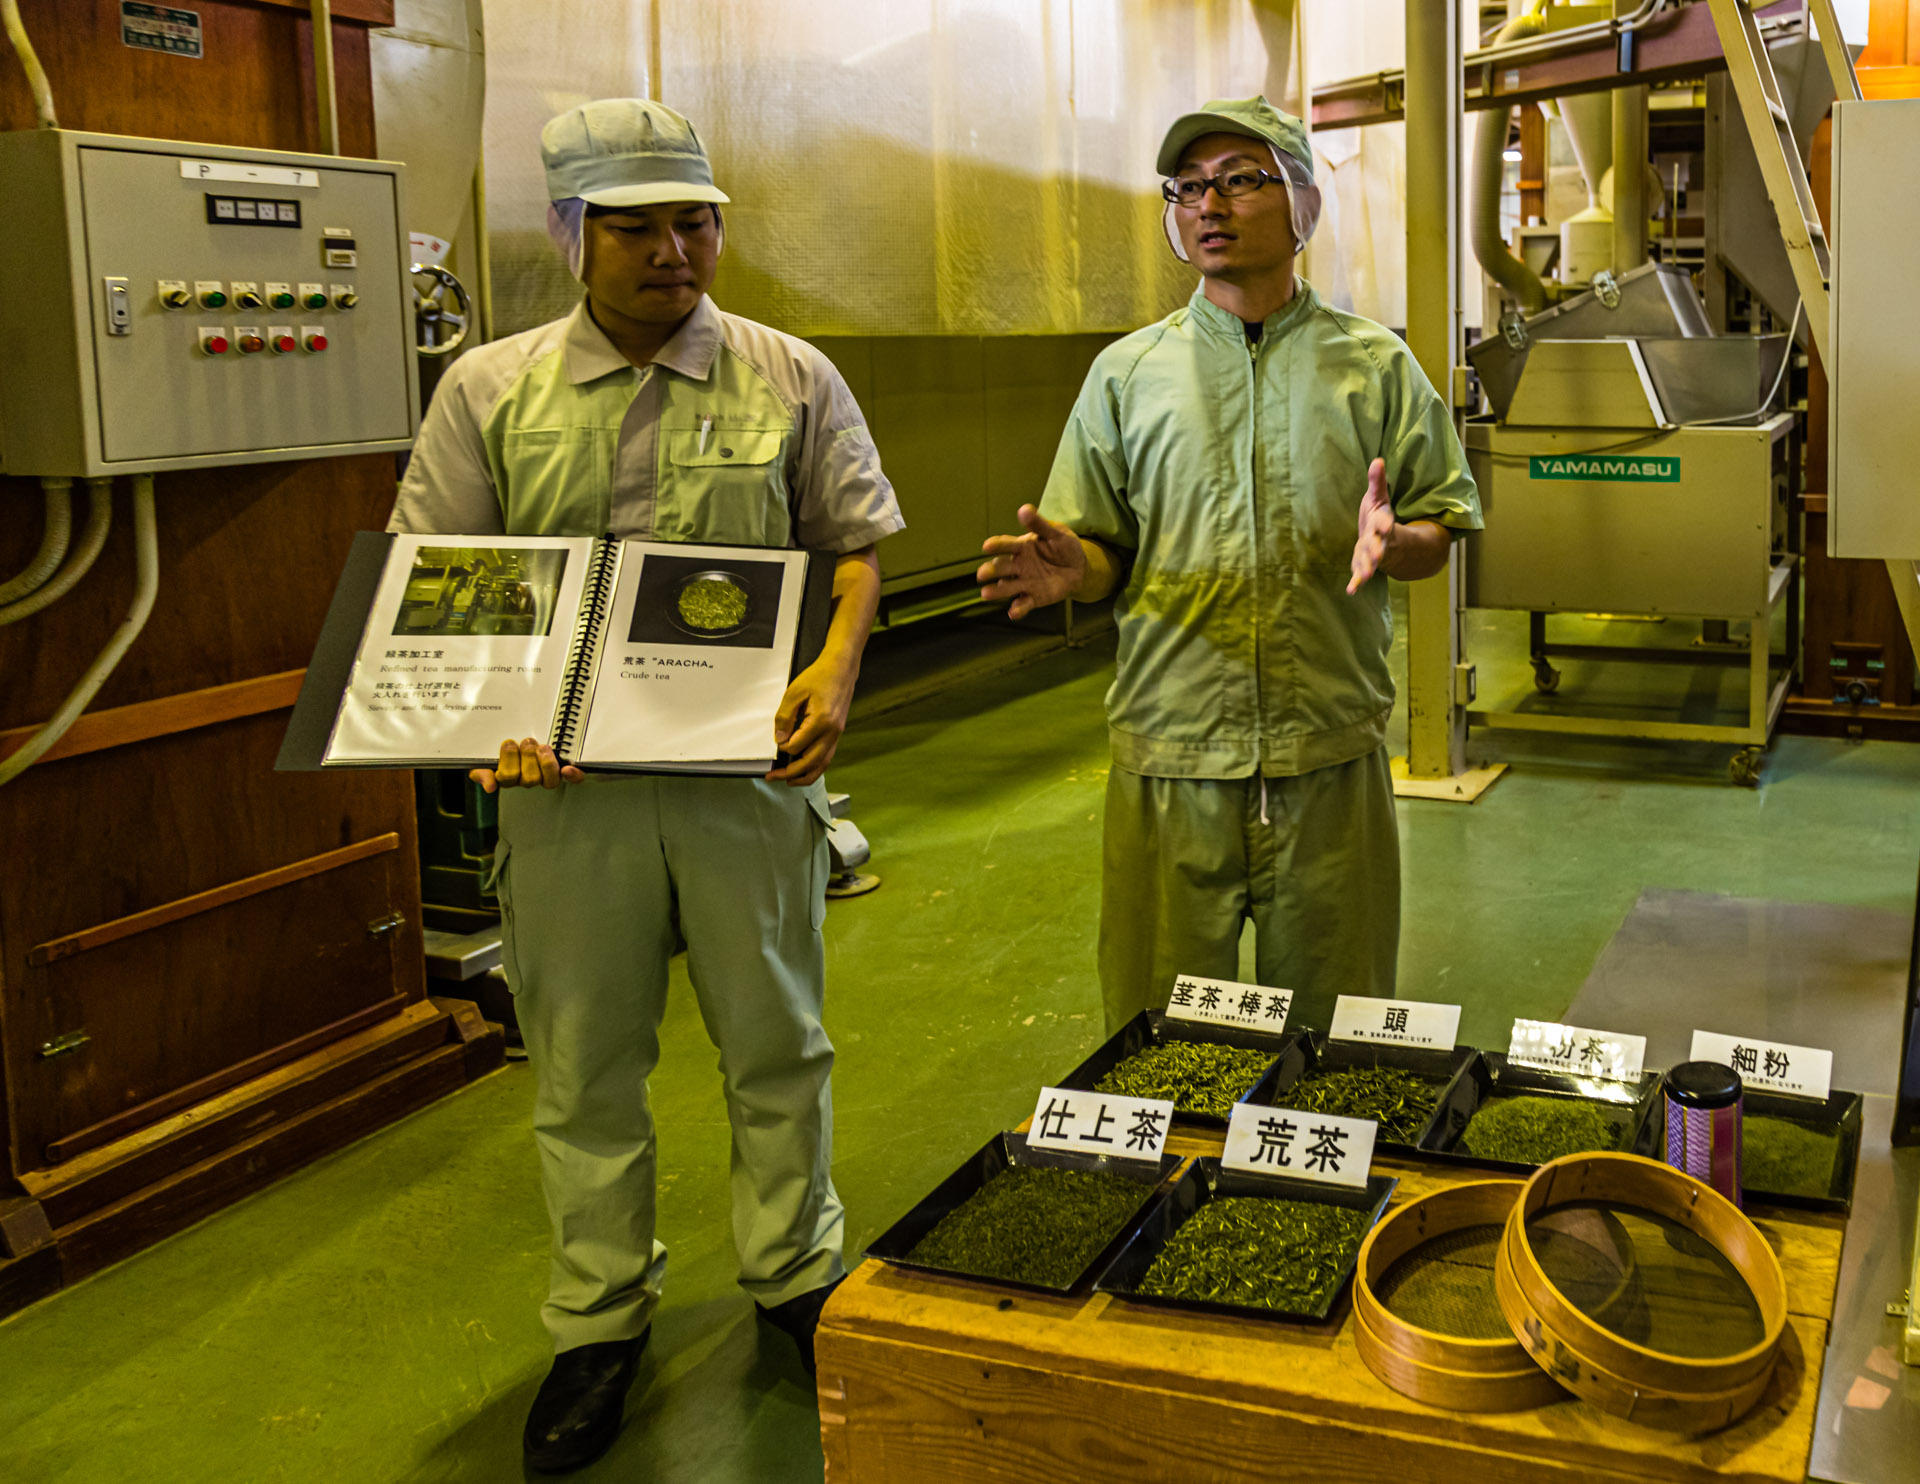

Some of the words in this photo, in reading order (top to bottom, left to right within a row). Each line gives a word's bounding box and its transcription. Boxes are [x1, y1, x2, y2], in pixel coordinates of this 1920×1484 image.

[1538, 460, 1672, 477] YAMAMASU
[423, 665, 438, 673] tea
[623, 656, 646, 666] 荒茶
[620, 671, 650, 680] Crude
[1171, 981, 1290, 1020] 茎茶・棒茶
[1382, 1007, 1410, 1033] 頭
[1731, 1044, 1790, 1079] 細粉
[1039, 1097, 1166, 1152] 仕上茶
[1250, 1117, 1349, 1174] 荒茶
